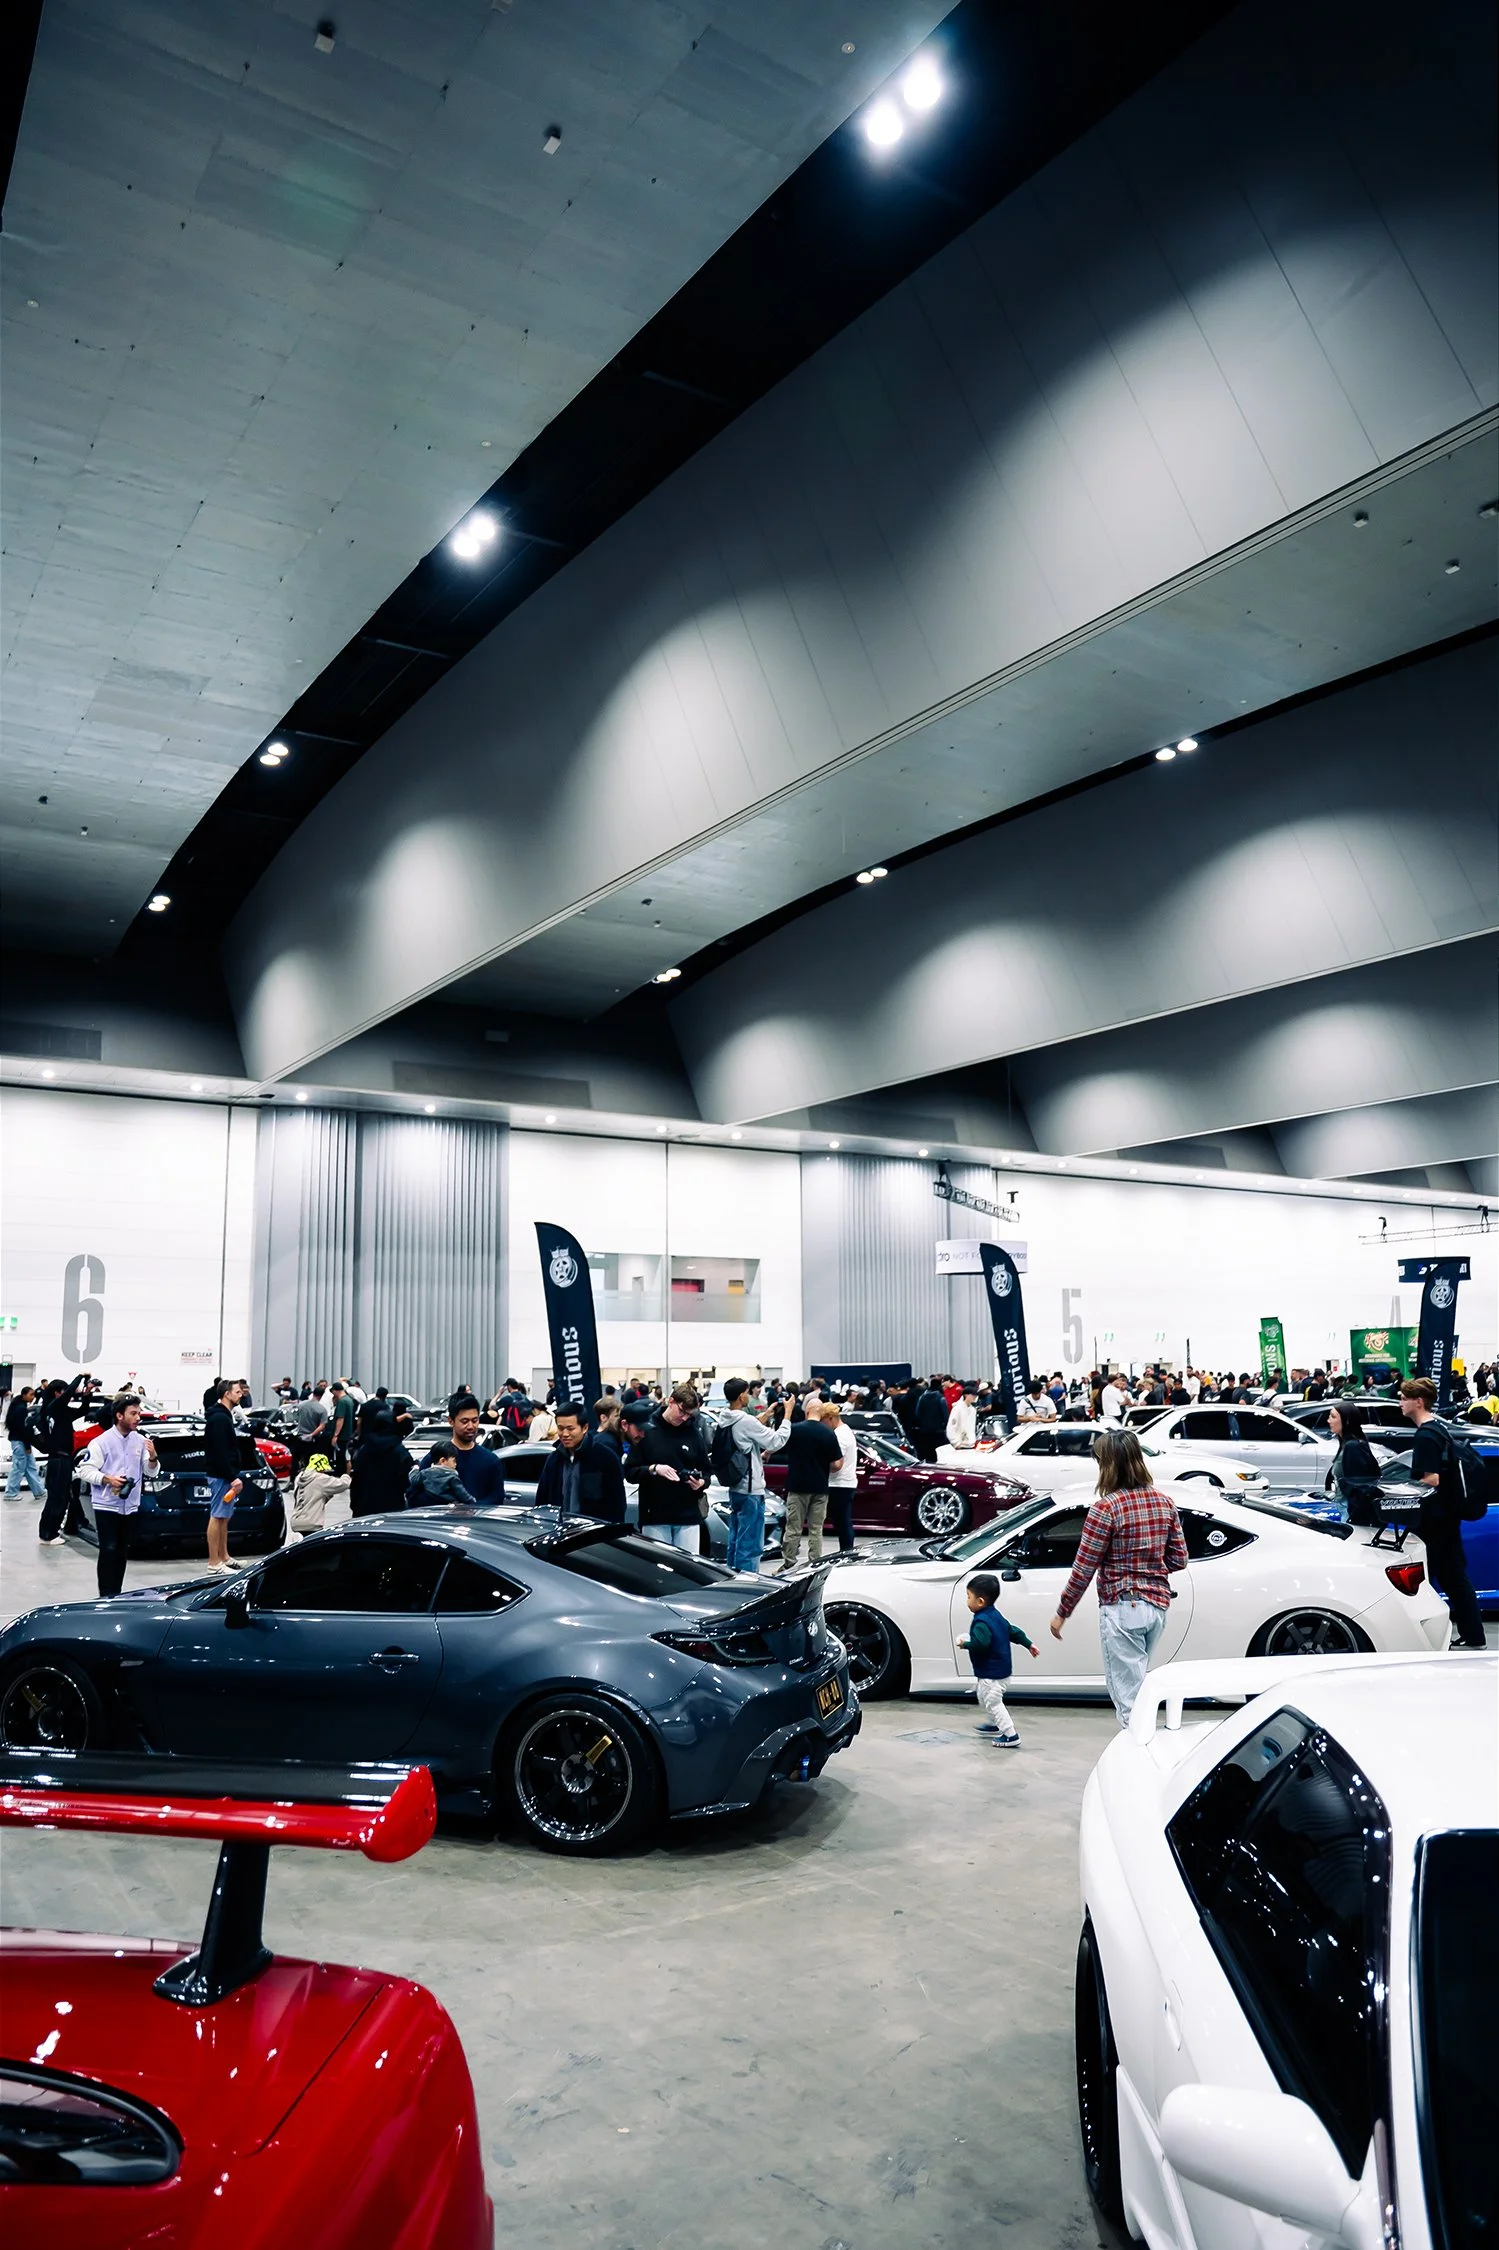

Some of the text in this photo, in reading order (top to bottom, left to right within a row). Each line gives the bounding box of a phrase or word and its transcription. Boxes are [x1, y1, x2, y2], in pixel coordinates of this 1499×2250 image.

[61, 1254, 106, 1365] 6
[1062, 1288, 1084, 1365] 5
[1004, 1328, 1026, 1408] torious
